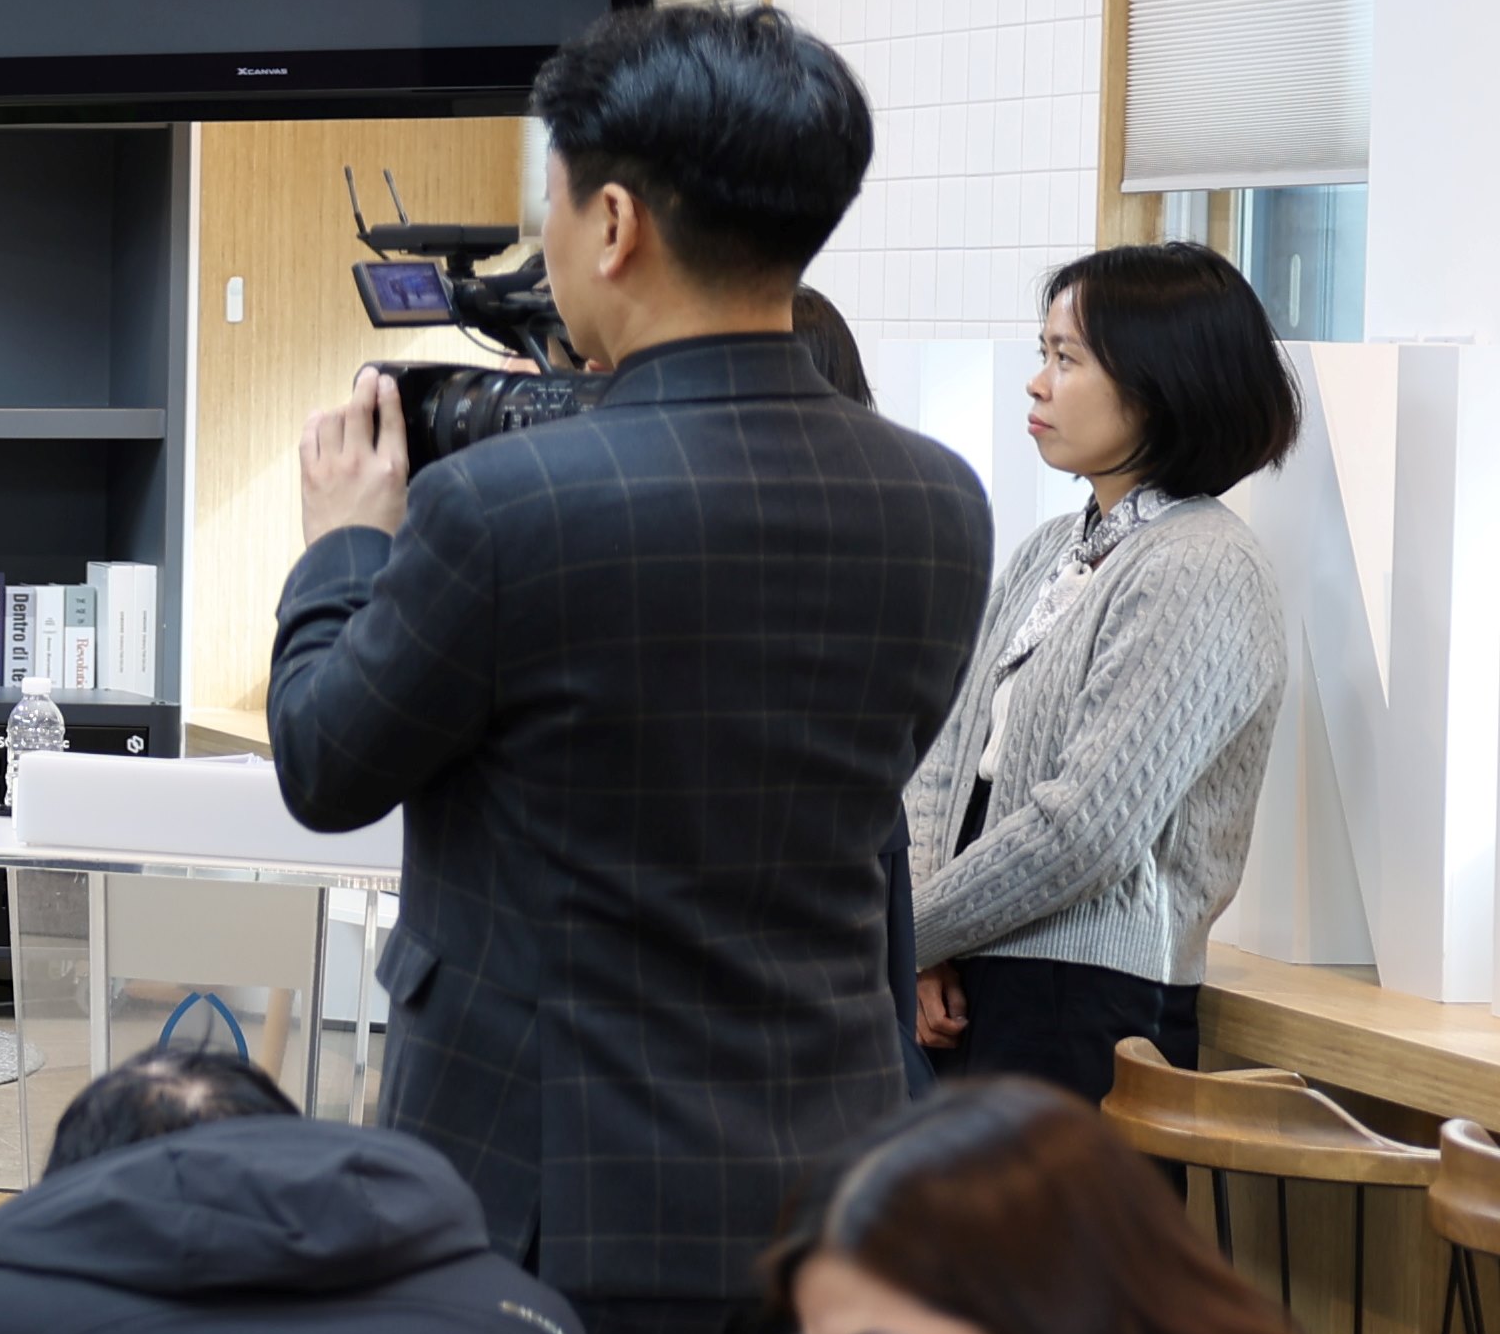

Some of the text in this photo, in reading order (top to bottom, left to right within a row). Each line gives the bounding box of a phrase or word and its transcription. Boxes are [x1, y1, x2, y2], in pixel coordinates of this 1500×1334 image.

[12, 592, 29, 683] Dentro di te
